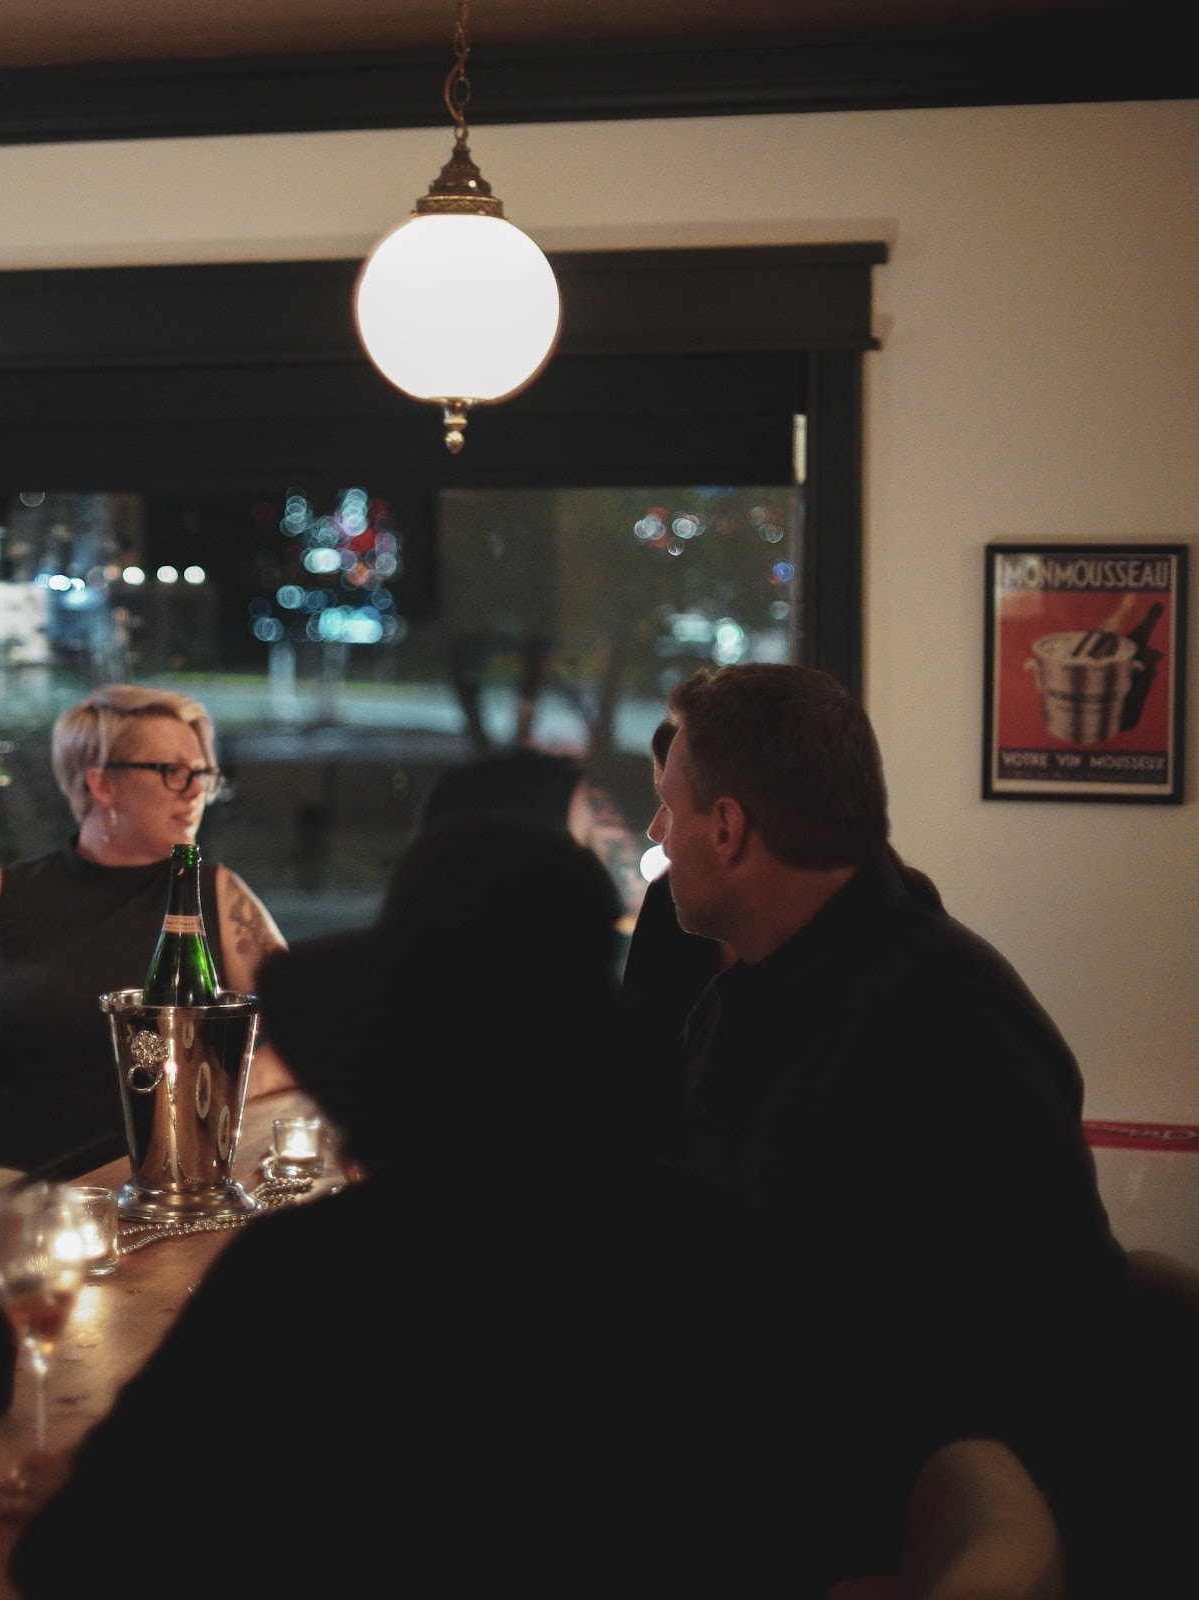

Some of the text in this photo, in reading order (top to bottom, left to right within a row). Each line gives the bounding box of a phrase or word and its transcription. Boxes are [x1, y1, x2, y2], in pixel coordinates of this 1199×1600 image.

[1003, 559, 1169, 588] MONMOUSSEAU
[1002, 753, 1049, 767] VOTRE
[1055, 754, 1082, 768] VIN
